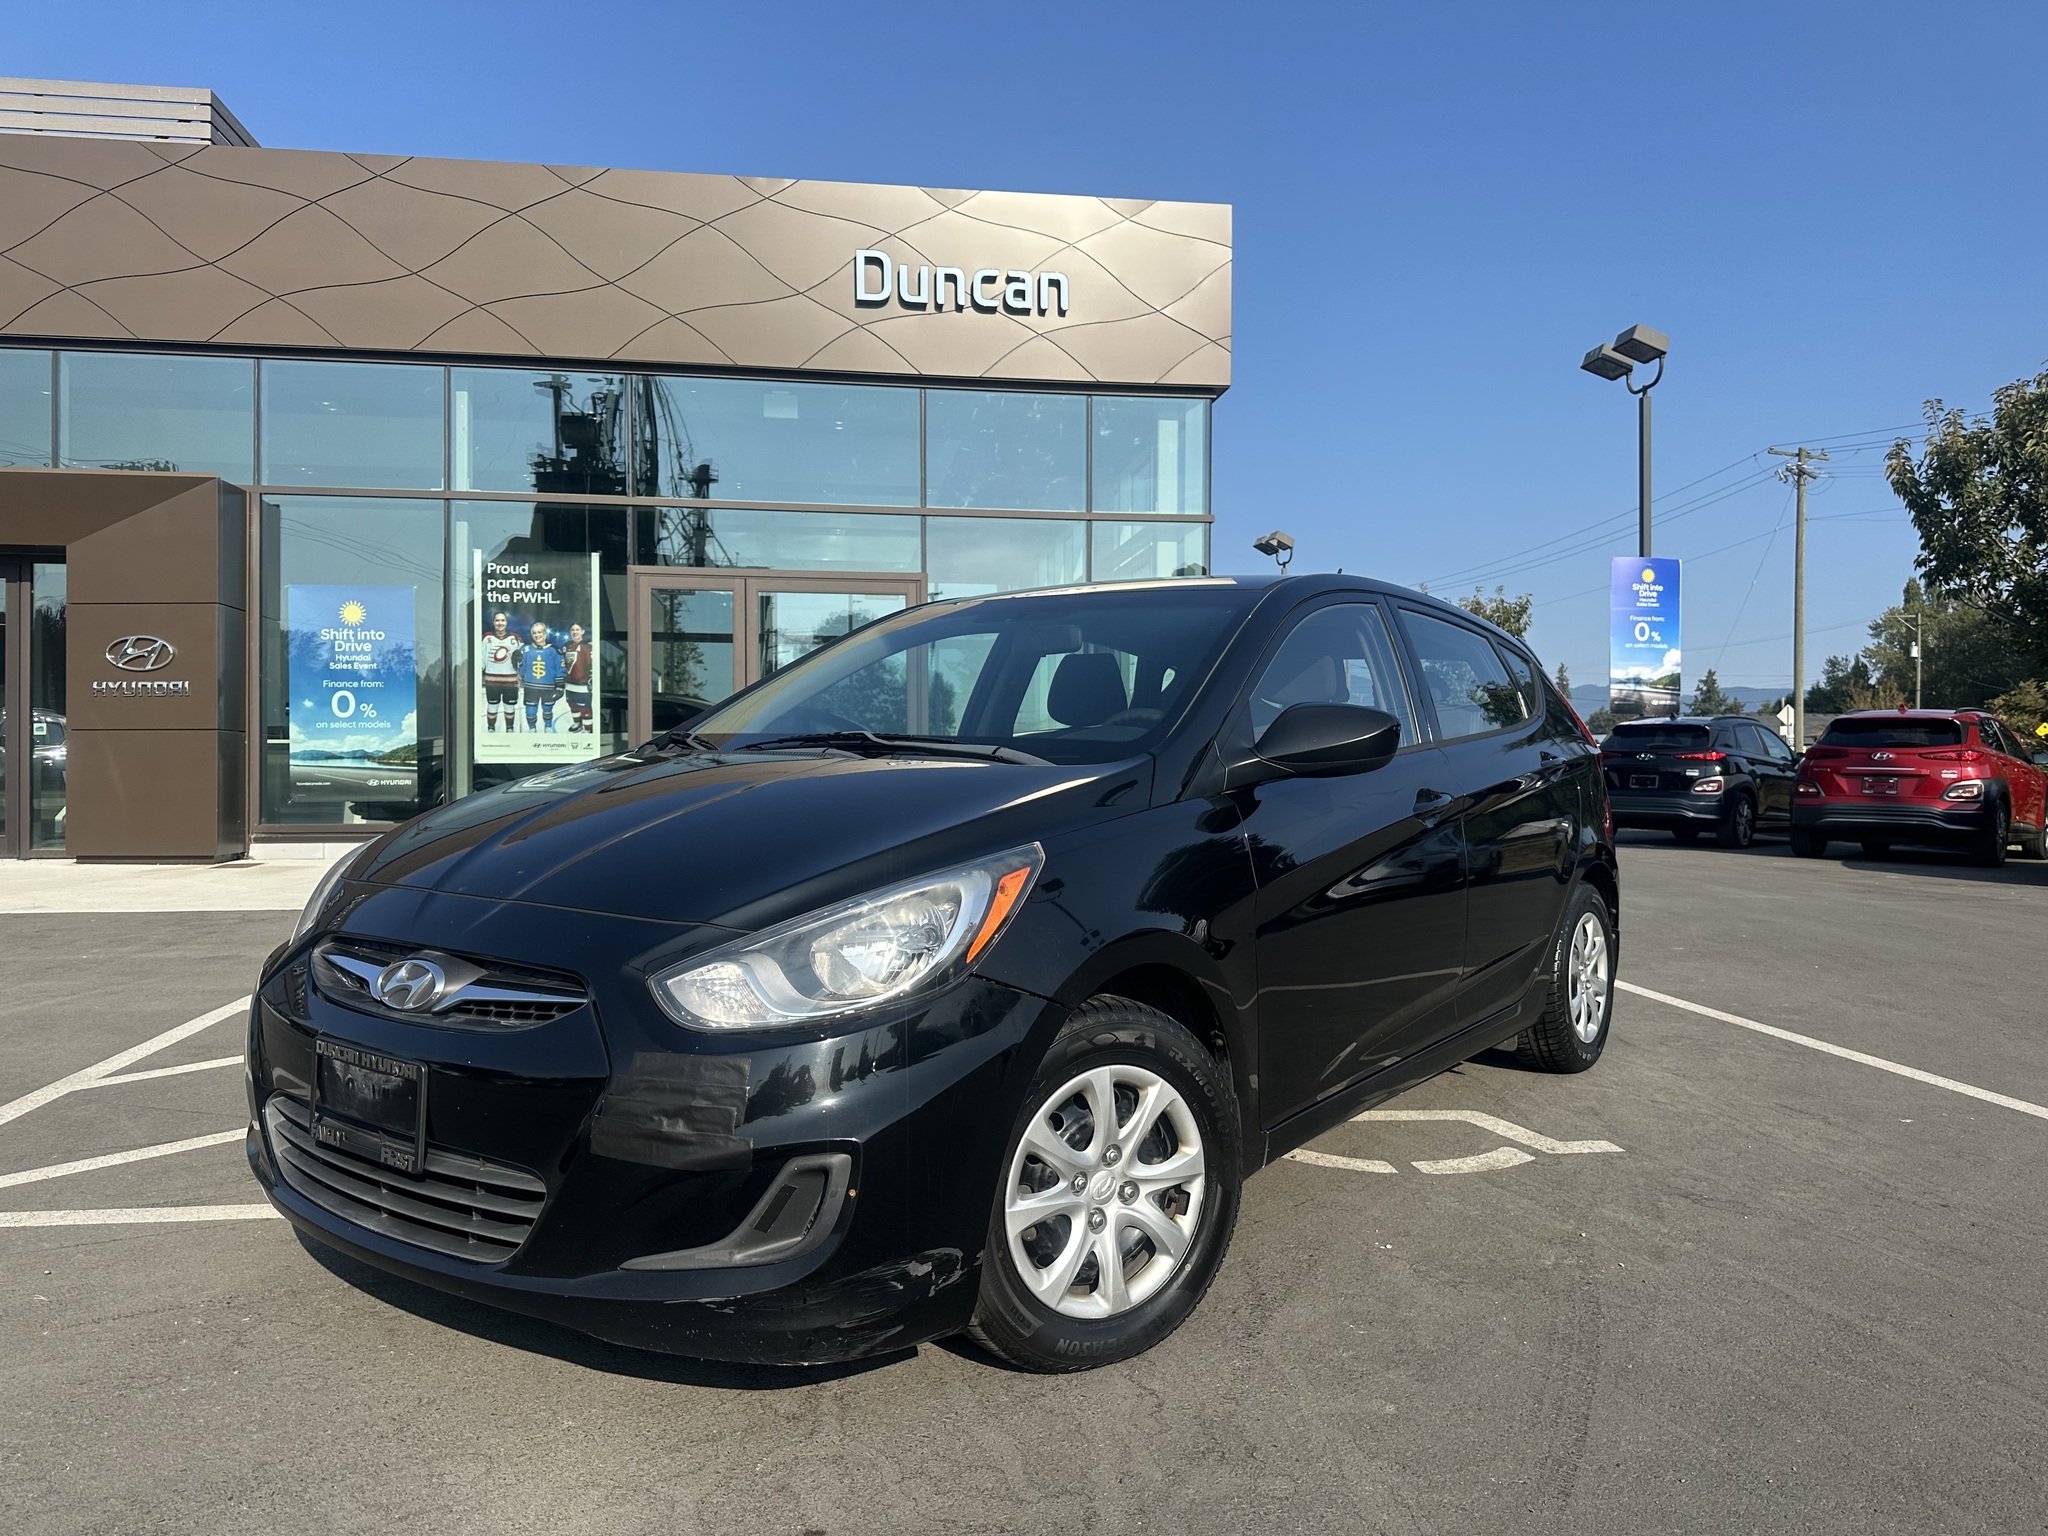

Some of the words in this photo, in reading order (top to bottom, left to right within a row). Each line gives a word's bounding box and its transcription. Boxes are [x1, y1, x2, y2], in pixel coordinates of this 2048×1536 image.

[855, 249, 1069, 314] Duncan
[487, 562, 529, 575] Proud
[487, 577, 540, 590] partner
[541, 578, 557, 589] of
[1632, 583, 1649, 591] Shift
[1650, 583, 1664, 592] into
[486, 591, 511, 603] the
[513, 592, 560, 604] PWHL.
[1639, 590, 1658, 598] Drive
[320, 628, 355, 640] Shift
[357, 628, 385, 640] into
[1634, 622, 1650, 642] 0
[1651, 631, 1661, 642] %
[334, 640, 372, 652] Drive
[335, 654, 371, 662] Hyundai
[329, 662, 352, 670] Sales
[353, 662, 378, 670] Event
[92, 681, 191, 697] HYUNDAI
[322, 680, 359, 688] Finance
[360, 680, 385, 688] from:
[331, 690, 356, 718] 0
[360, 703, 377, 718] %
[358, 720, 391, 728] models
